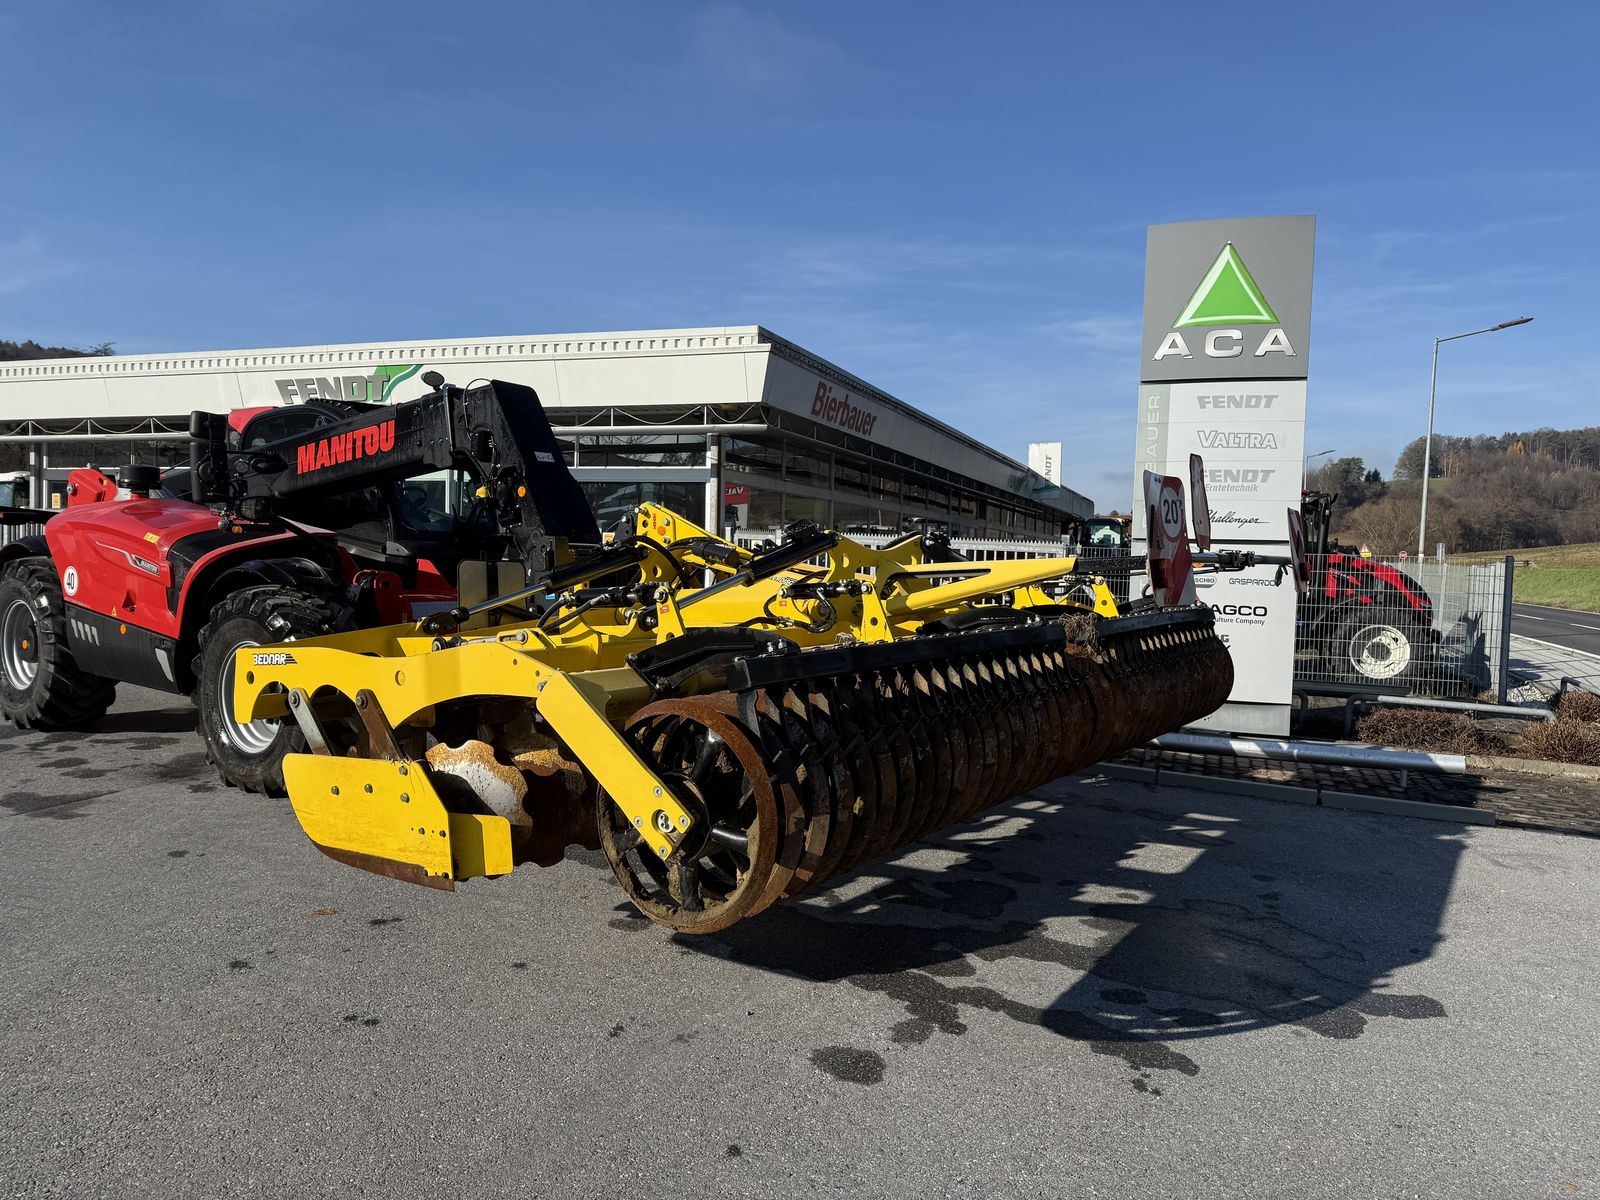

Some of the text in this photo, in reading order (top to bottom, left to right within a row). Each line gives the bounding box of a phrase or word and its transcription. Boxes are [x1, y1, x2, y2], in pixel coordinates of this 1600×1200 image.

[1152, 328, 1297, 361] ACA
[274, 375, 390, 405] FENDT
[811, 381, 878, 437] Bierbauer
[1197, 394, 1279, 410] FENDT
[1144, 395, 1161, 474] BAUER
[1197, 430, 1278, 449] VALTRA
[297, 420, 395, 474] MANITOU
[1163, 498, 1179, 525] 20
[66, 572, 75, 590] 40
[1211, 604, 1268, 617] AGCO
[1235, 618, 1266, 626] Company
[253, 653, 287, 666] BEDNAR
